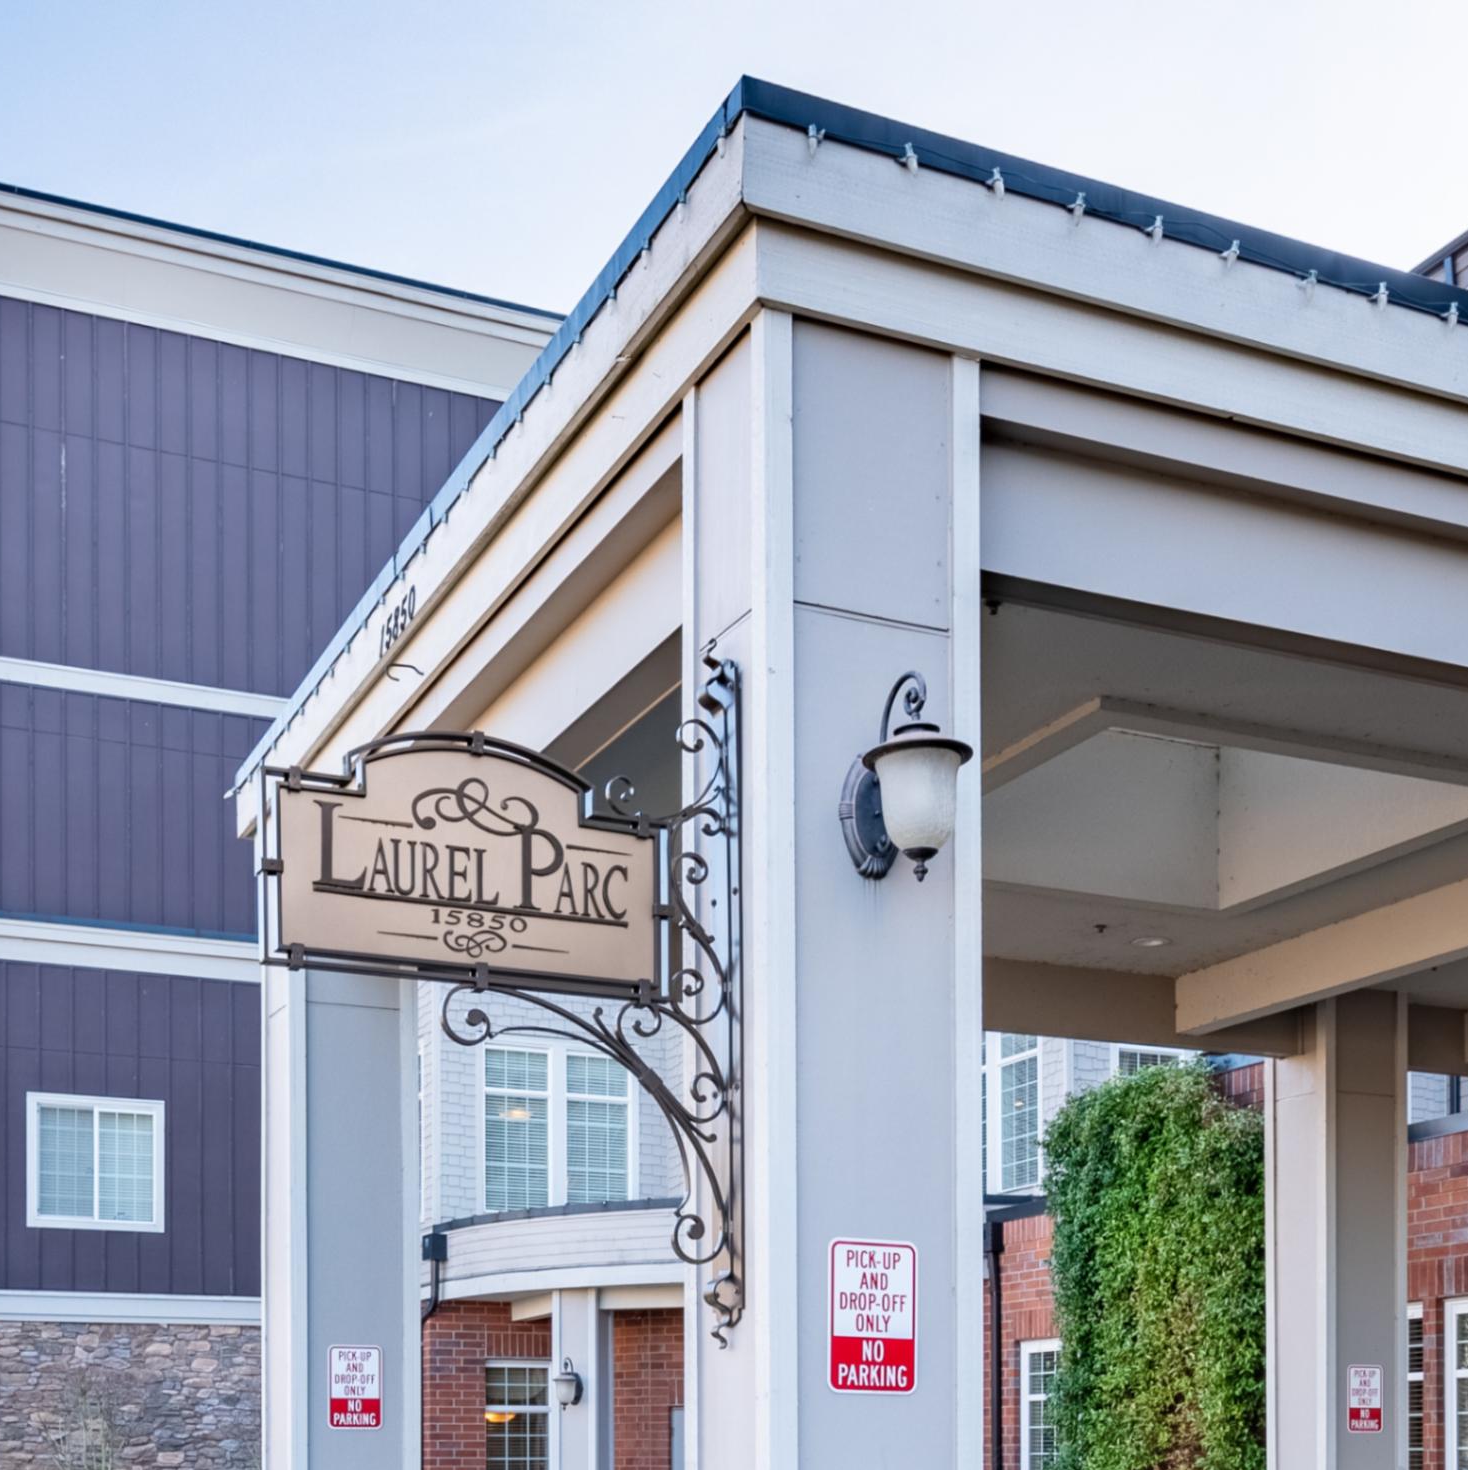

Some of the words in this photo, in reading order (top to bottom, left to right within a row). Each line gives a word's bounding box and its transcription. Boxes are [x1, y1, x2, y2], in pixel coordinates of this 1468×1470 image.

[312, 799, 500, 906] LAUREL
[513, 824, 629, 921] PARC
[431, 908, 528, 933] 15850
[846, 1250, 901, 1270] PICK-UP
[860, 1272, 888, 1291] AND
[839, 1292, 907, 1312] DROP-OFF
[855, 1313, 891, 1333] ONLY
[862, 1340, 885, 1362] NO
[346, 1363, 364, 1373] AND
[838, 1363, 908, 1388] PARKING
[344, 1386, 366, 1396] ONLY
[347, 1399, 362, 1412] NO
[1360, 1409, 1371, 1419] NO
[333, 1412, 376, 1426] PARKING
[1351, 1419, 1379, 1430] PARKING
